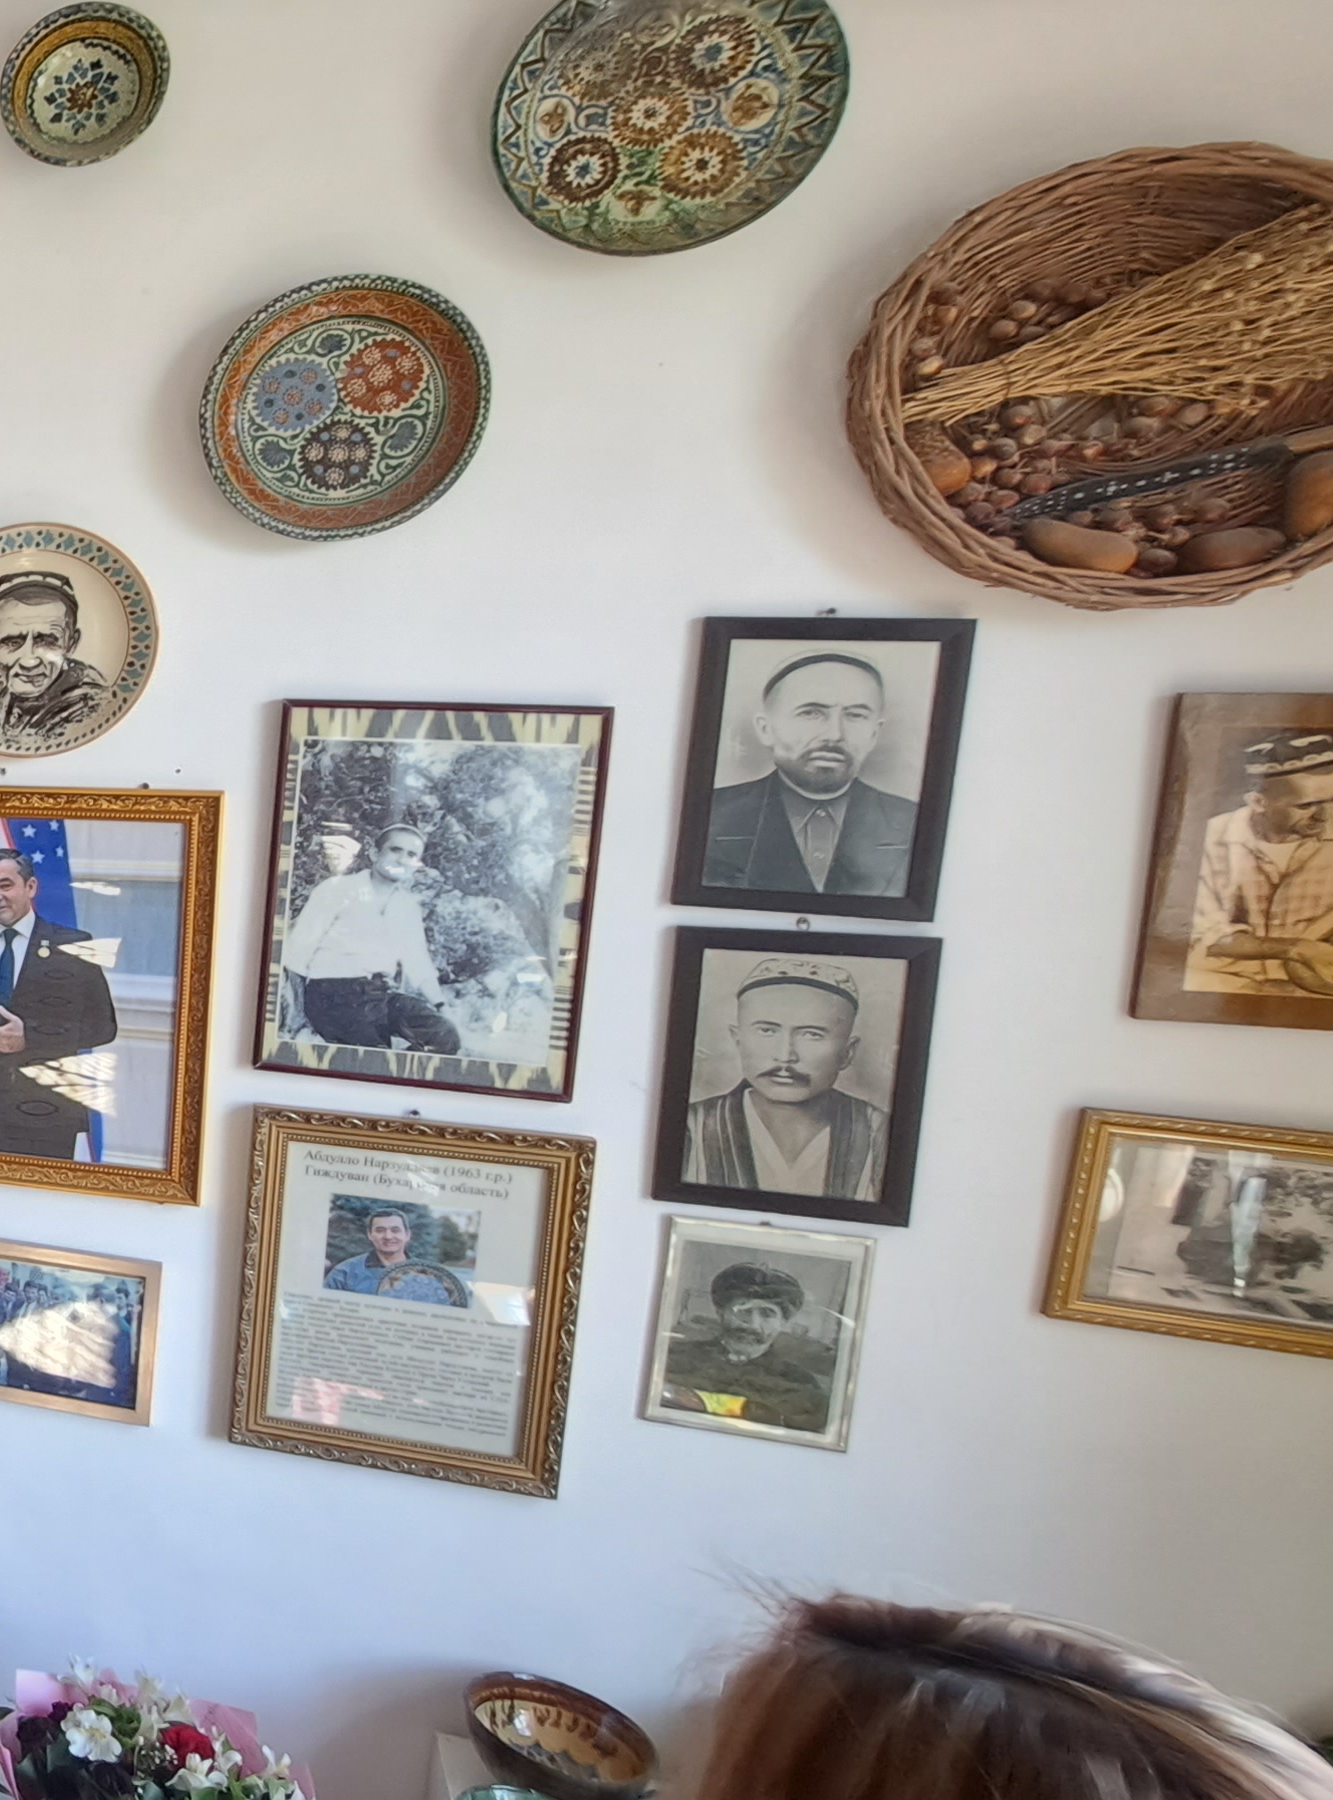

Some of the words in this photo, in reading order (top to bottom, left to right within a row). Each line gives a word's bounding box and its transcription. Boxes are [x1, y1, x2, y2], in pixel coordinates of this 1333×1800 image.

[304, 1150, 360, 1166] Абдулло
[443, 1164, 481, 1179] (1963
[304, 1165, 369, 1183] Гиждуван
[449, 1184, 509, 1200] область)
